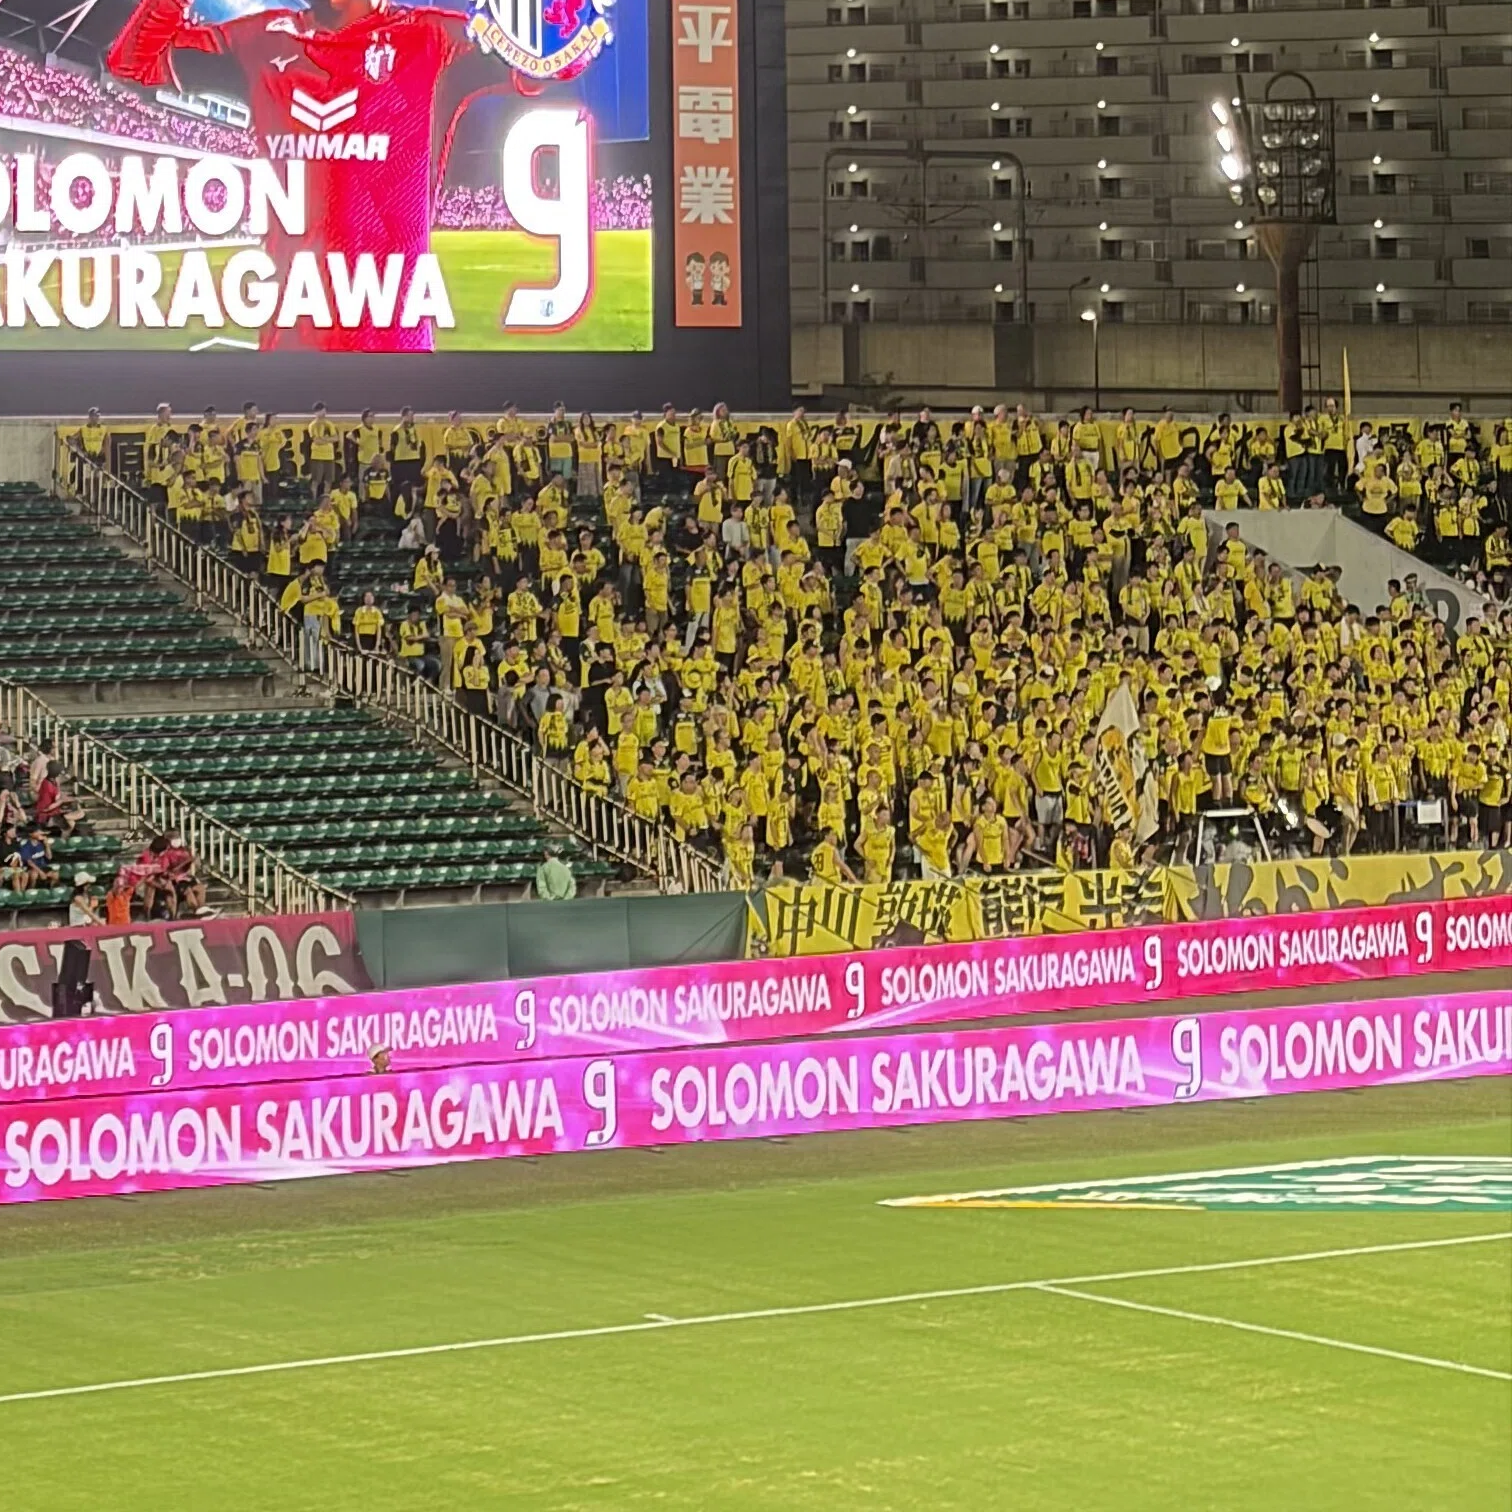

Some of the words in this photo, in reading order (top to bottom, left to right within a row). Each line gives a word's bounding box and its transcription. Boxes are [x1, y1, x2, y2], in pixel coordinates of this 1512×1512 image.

[490, 29, 539, 72] CEREZO
[543, 34, 590, 72] OSAKA
[266, 134, 390, 161] YANMAR
[501, 107, 594, 330] 9
[149, 1023, 173, 1086] 9
[189, 1021, 319, 1072] SOLOMON
[326, 1003, 498, 1058] SAKURAGAWA
[514, 990, 536, 1051] 9
[549, 989, 680, 1035] SOLOMON
[674, 974, 831, 1026] SAKURAGAWA
[845, 961, 865, 1019] 9
[881, 960, 988, 1005] SOLOMON
[994, 945, 1136, 997] SAKURAGAWA
[1144, 935, 1163, 990] 9
[1177, 933, 1274, 977] SOLOMON
[1279, 920, 1409, 967] SAKURAGAWA
[1415, 911, 1433, 964] 9
[4, 1105, 241, 1189] SOLOMON
[255, 1077, 564, 1164] SAKURAGAWA
[583, 1058, 617, 1148] 9
[651, 1056, 858, 1132] SOLOMON
[871, 1035, 1146, 1113] SAKURAGAWA
[1172, 1018, 1203, 1101] 9
[1220, 1013, 1403, 1086] SOLOMON
